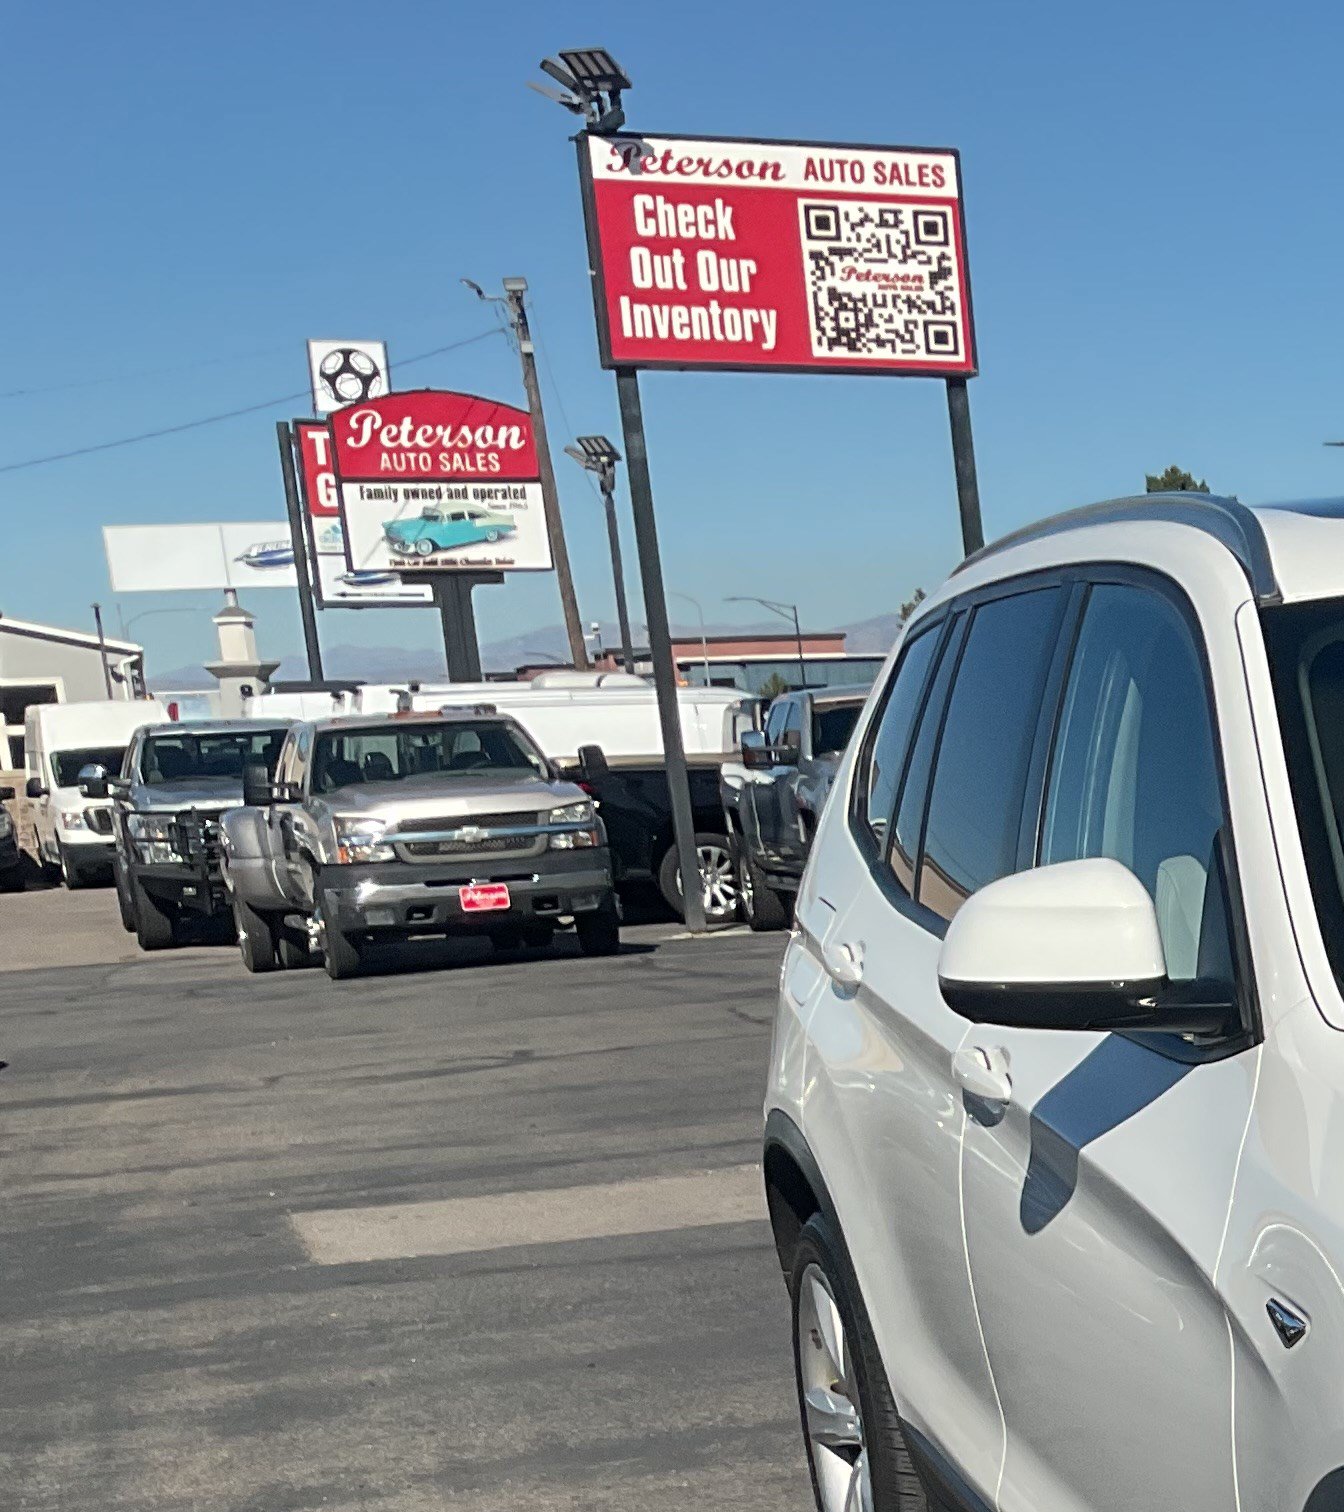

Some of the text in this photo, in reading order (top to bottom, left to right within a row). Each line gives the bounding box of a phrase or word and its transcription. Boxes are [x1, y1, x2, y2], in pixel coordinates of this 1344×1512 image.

[606, 141, 945, 188] Peterson AUTO SALES
[632, 194, 736, 240] Check
[629, 246, 757, 293] Out Our
[620, 296, 777, 350] Inventory
[347, 409, 526, 450] Peterson
[380, 452, 501, 473] AUTO SALES
[359, 485, 527, 503] Family owned and operated
